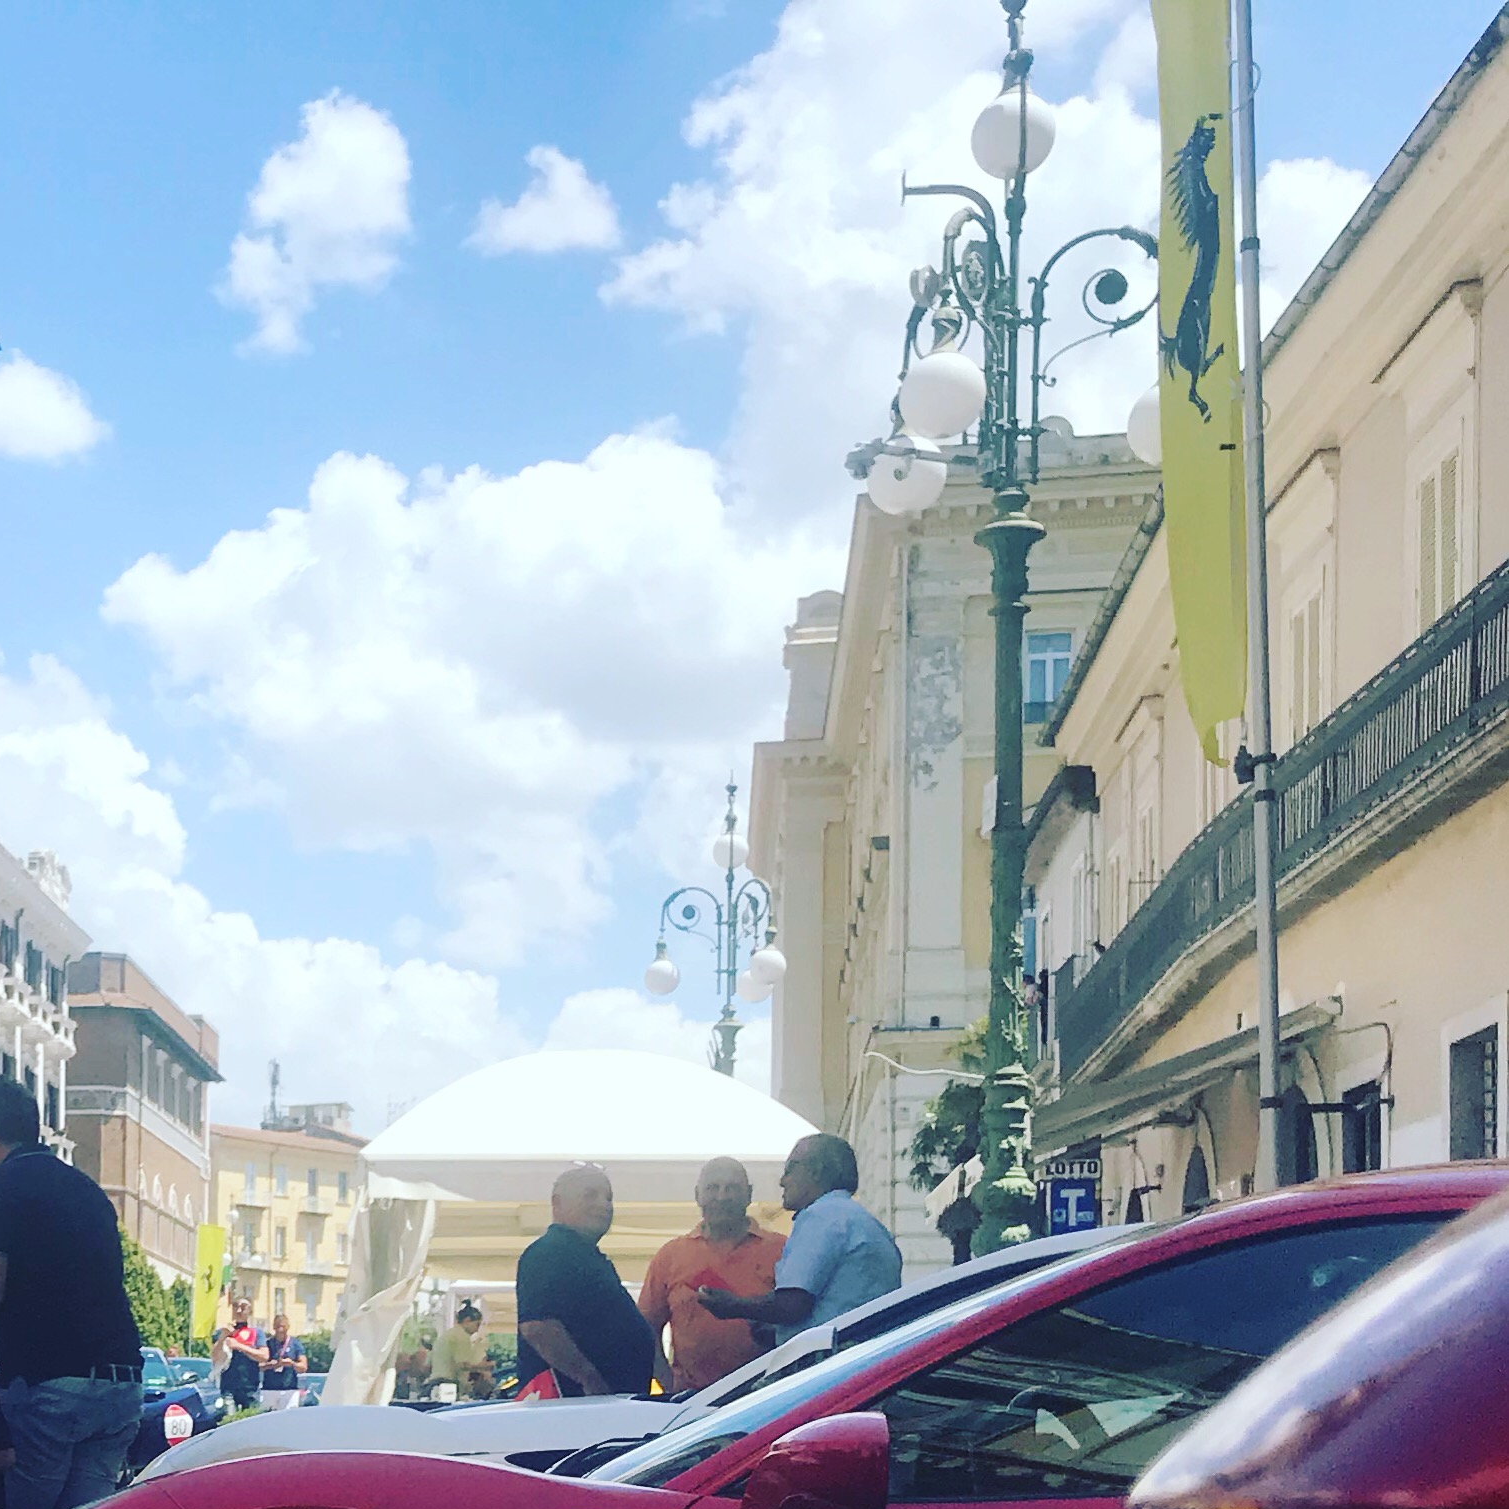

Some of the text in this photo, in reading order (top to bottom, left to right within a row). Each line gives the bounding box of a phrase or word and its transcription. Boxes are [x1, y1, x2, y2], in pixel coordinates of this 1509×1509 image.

[1045, 1160, 1098, 1175] LOTTO
[1060, 1188, 1086, 1226] T
[171, 1419, 187, 1436] 80
